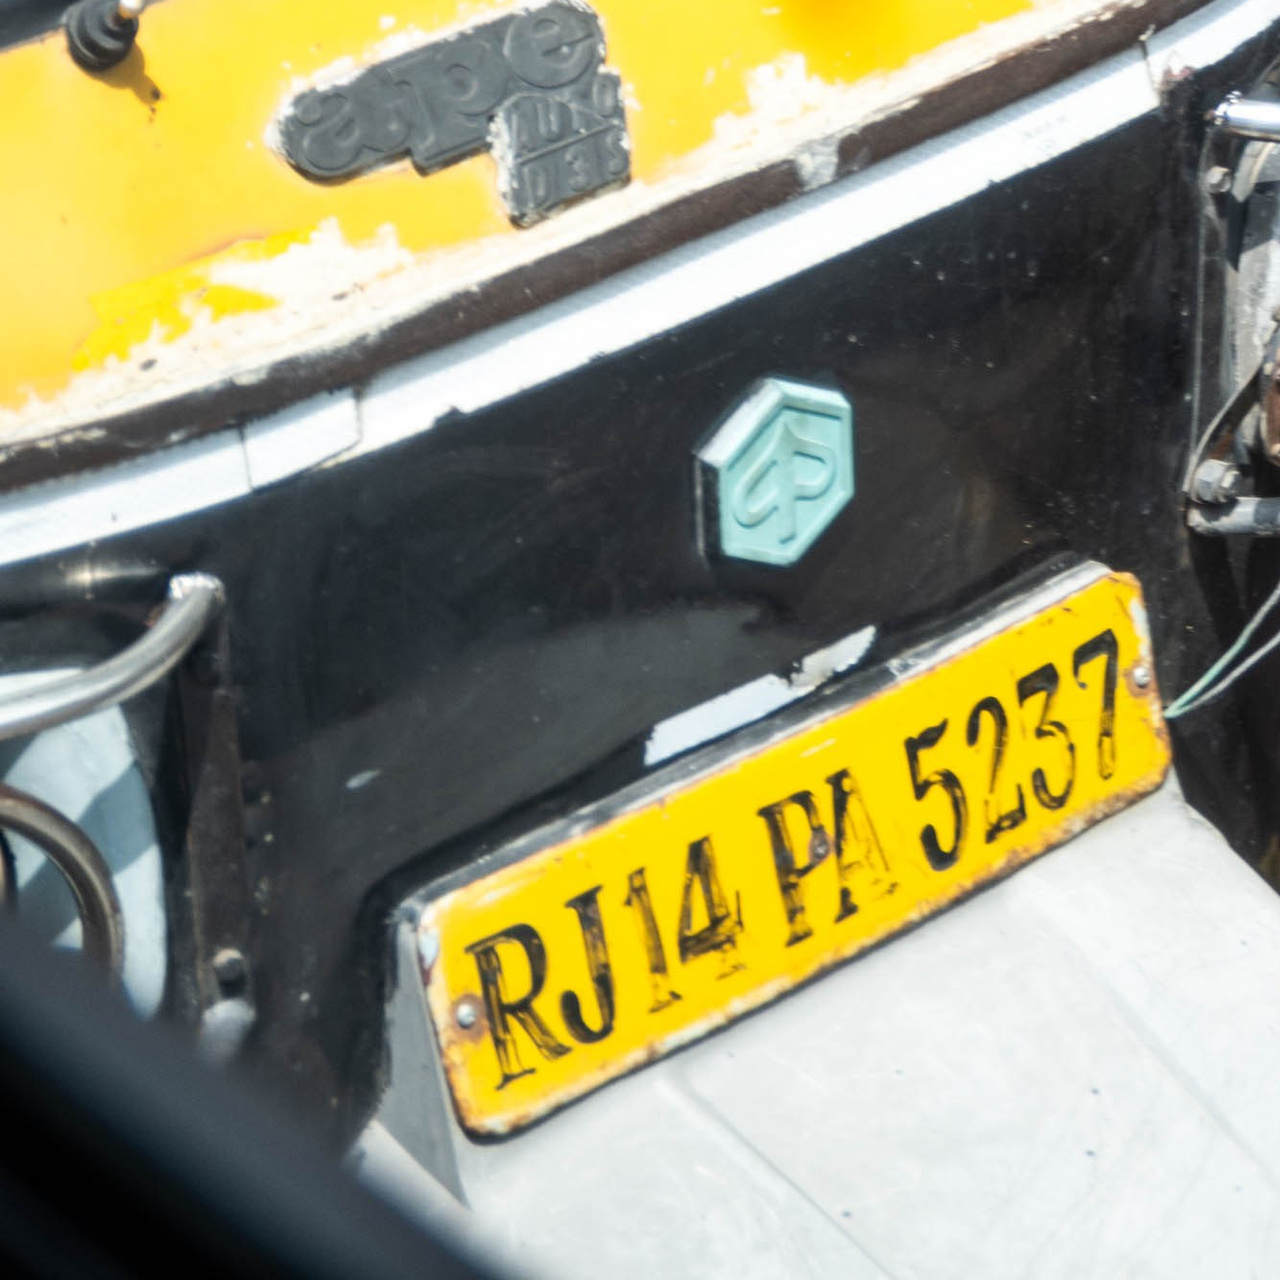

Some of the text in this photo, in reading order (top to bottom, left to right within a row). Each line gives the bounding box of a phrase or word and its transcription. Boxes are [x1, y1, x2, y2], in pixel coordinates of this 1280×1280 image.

[297, 2, 601, 171] ape
[464, 628, 1119, 1091] RJ14 PA 5237
